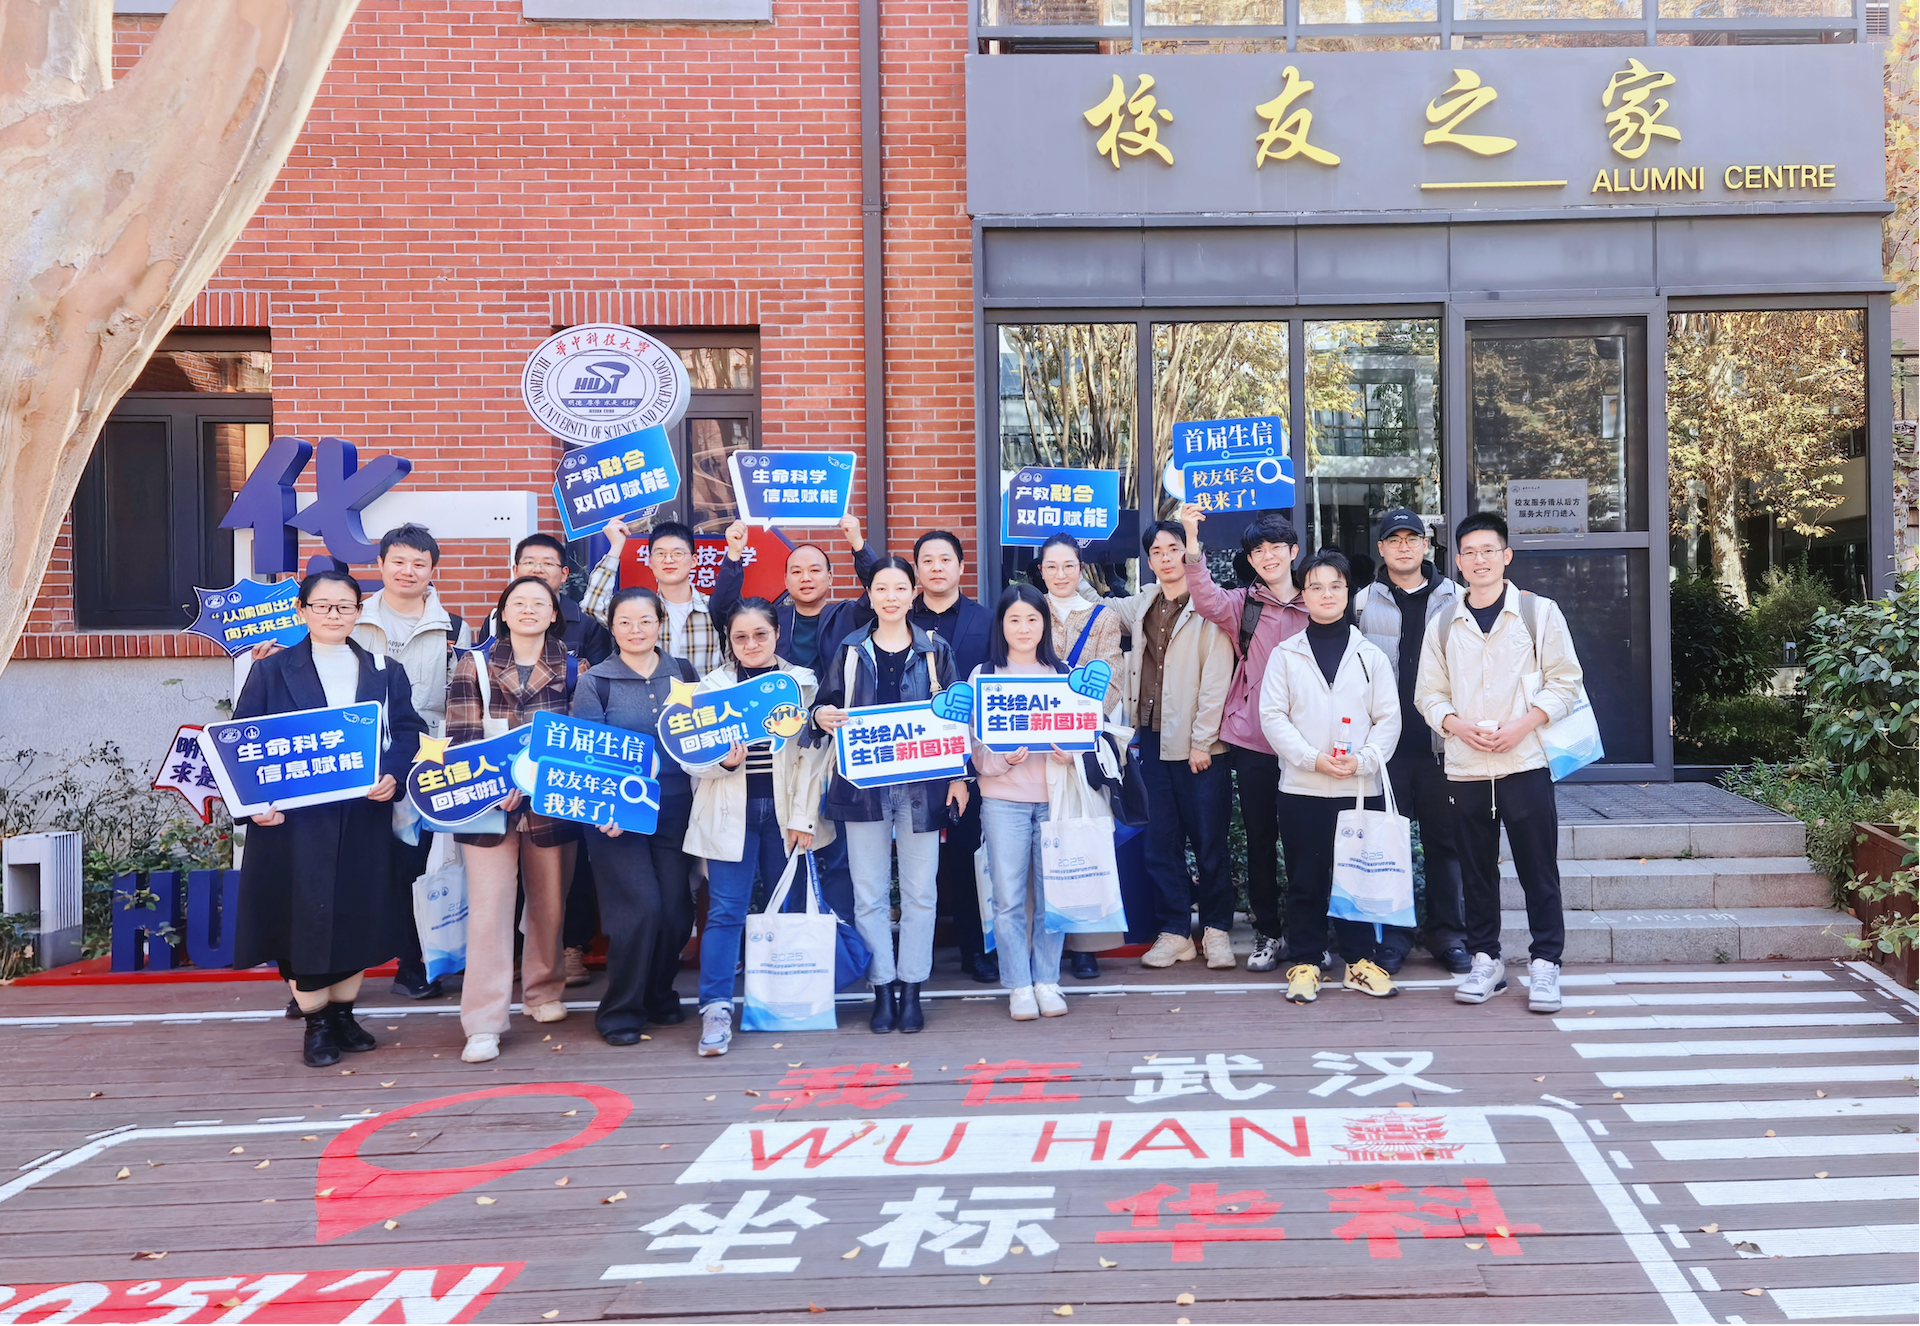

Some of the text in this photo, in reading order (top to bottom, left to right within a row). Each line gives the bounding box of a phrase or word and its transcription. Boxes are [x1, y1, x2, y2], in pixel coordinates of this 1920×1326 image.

[1083, 58, 1683, 169] 校友之家
[1592, 163, 1835, 194] ALUMNI CENTRE
[539, 402, 590, 438] UNIVERSITY
[591, 425, 602, 439] OF
[604, 418, 640, 439] SCIENCE
[640, 408, 658, 428] AND
[651, 356, 673, 414] TECHNOLOGY
[1182, 421, 1273, 454] 首届生信
[564, 448, 645, 490] 产教融合
[752, 469, 827, 484] 生命科学
[1192, 466, 1255, 488] 校友年会
[573, 466, 670, 515] 双向赋能
[762, 488, 838, 503] 信息赋能
[1015, 484, 1094, 503] 产教融合
[1193, 488, 1257, 511] 我来了!
[1515, 498, 1580, 507] 校友服务请从后方
[1017, 506, 1108, 528] 双向赋能
[1519, 509, 1576, 518] 服务大厅门进入
[667, 700, 742, 735] 生信人
[986, 694, 1061, 711] 共绘AI+
[848, 722, 926, 746] 共绘AI+
[987, 712, 1098, 732] 生信新图谱
[237, 729, 345, 762] 生命科学
[544, 720, 645, 763] 首届生信
[679, 722, 749, 754] 回家啦!
[851, 735, 965, 766] 生信新图谱
[256, 751, 364, 785] 信息赋能
[416, 754, 500, 793] 生信人
[546, 767, 618, 797] 校友年会
[430, 777, 508, 813] 回家啦!
[543, 792, 616, 822] 我来了!
[1058, 856, 1085, 868] 2025
[771, 952, 803, 962] 2025
[751, 1050, 1463, 1112] 我在武汉
[749, 1115, 1314, 1172] WU HAN
[600, 1177, 1542, 1280] 坐标华科
